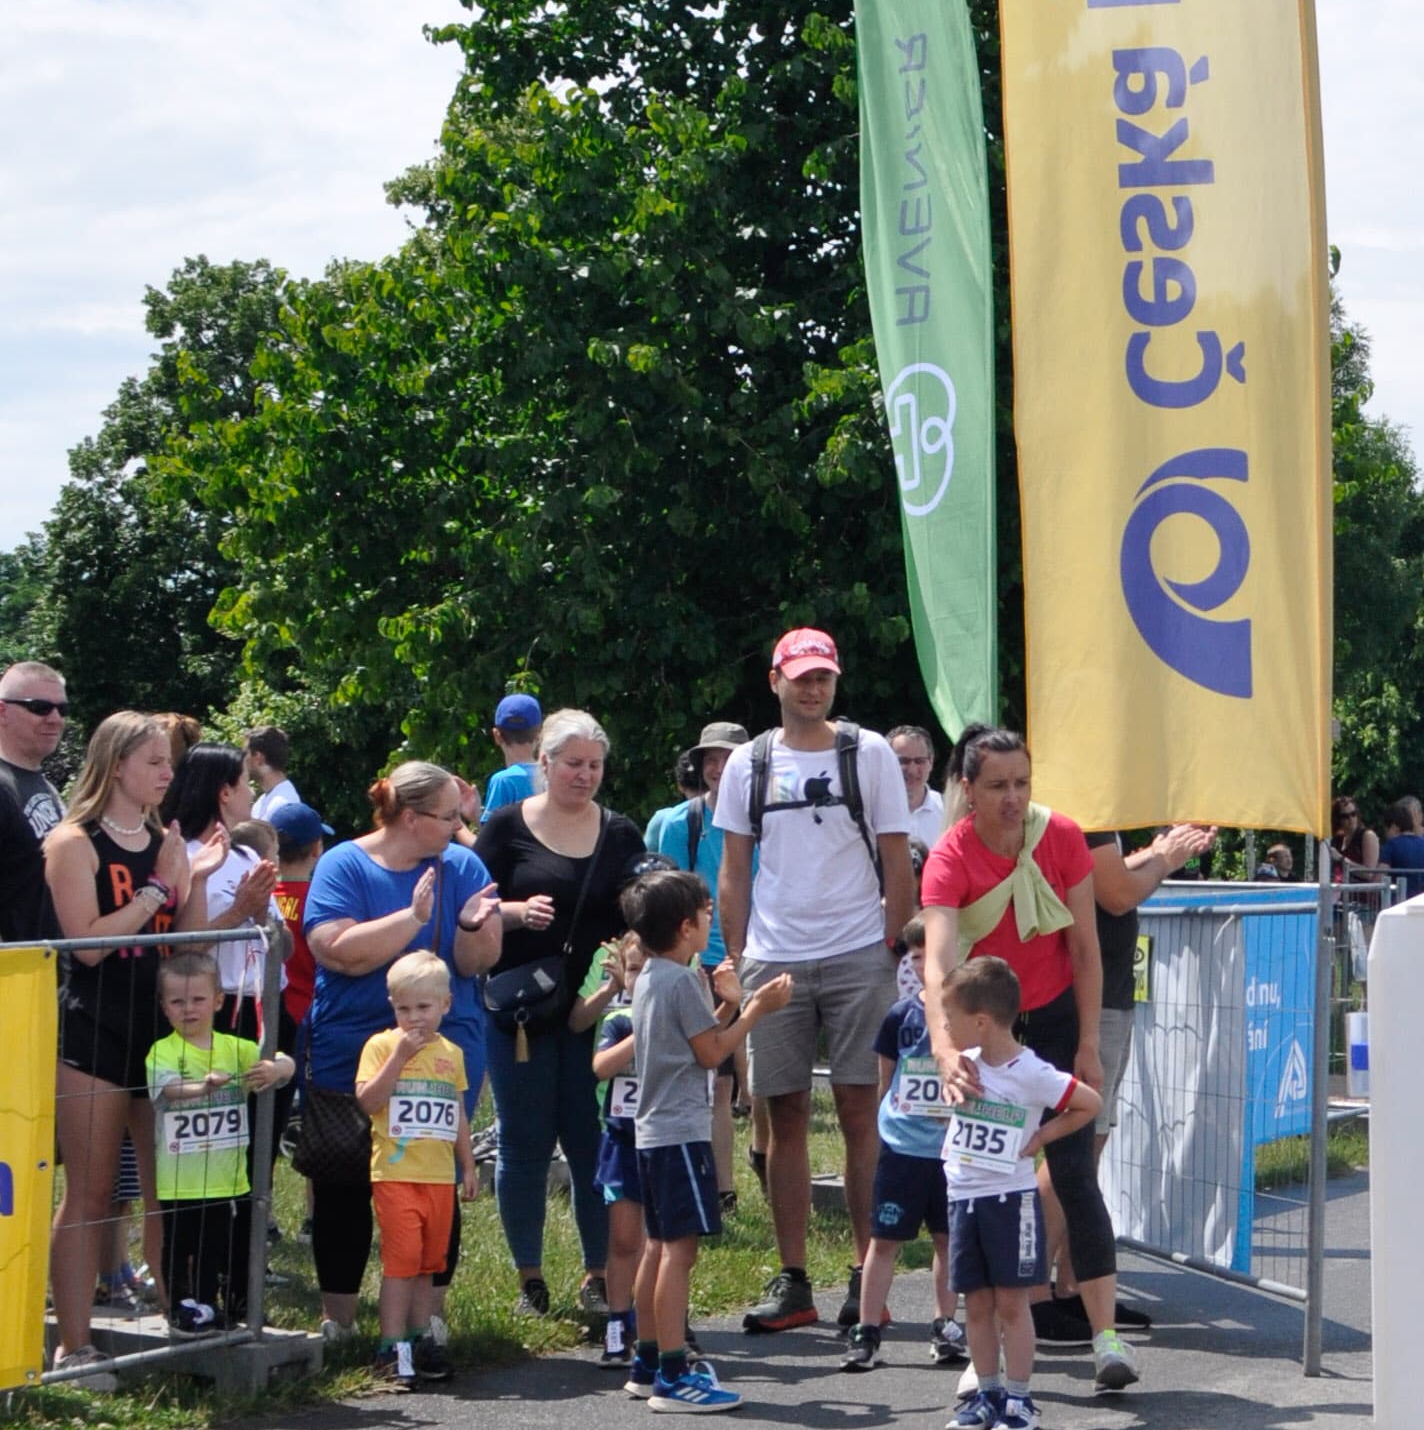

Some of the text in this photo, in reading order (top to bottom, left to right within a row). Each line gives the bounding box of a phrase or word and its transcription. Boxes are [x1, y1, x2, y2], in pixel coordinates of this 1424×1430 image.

[173, 1108, 242, 1139] 2079
[397, 1099, 455, 1126] 2076
[951, 1119, 1008, 1155] 2135
